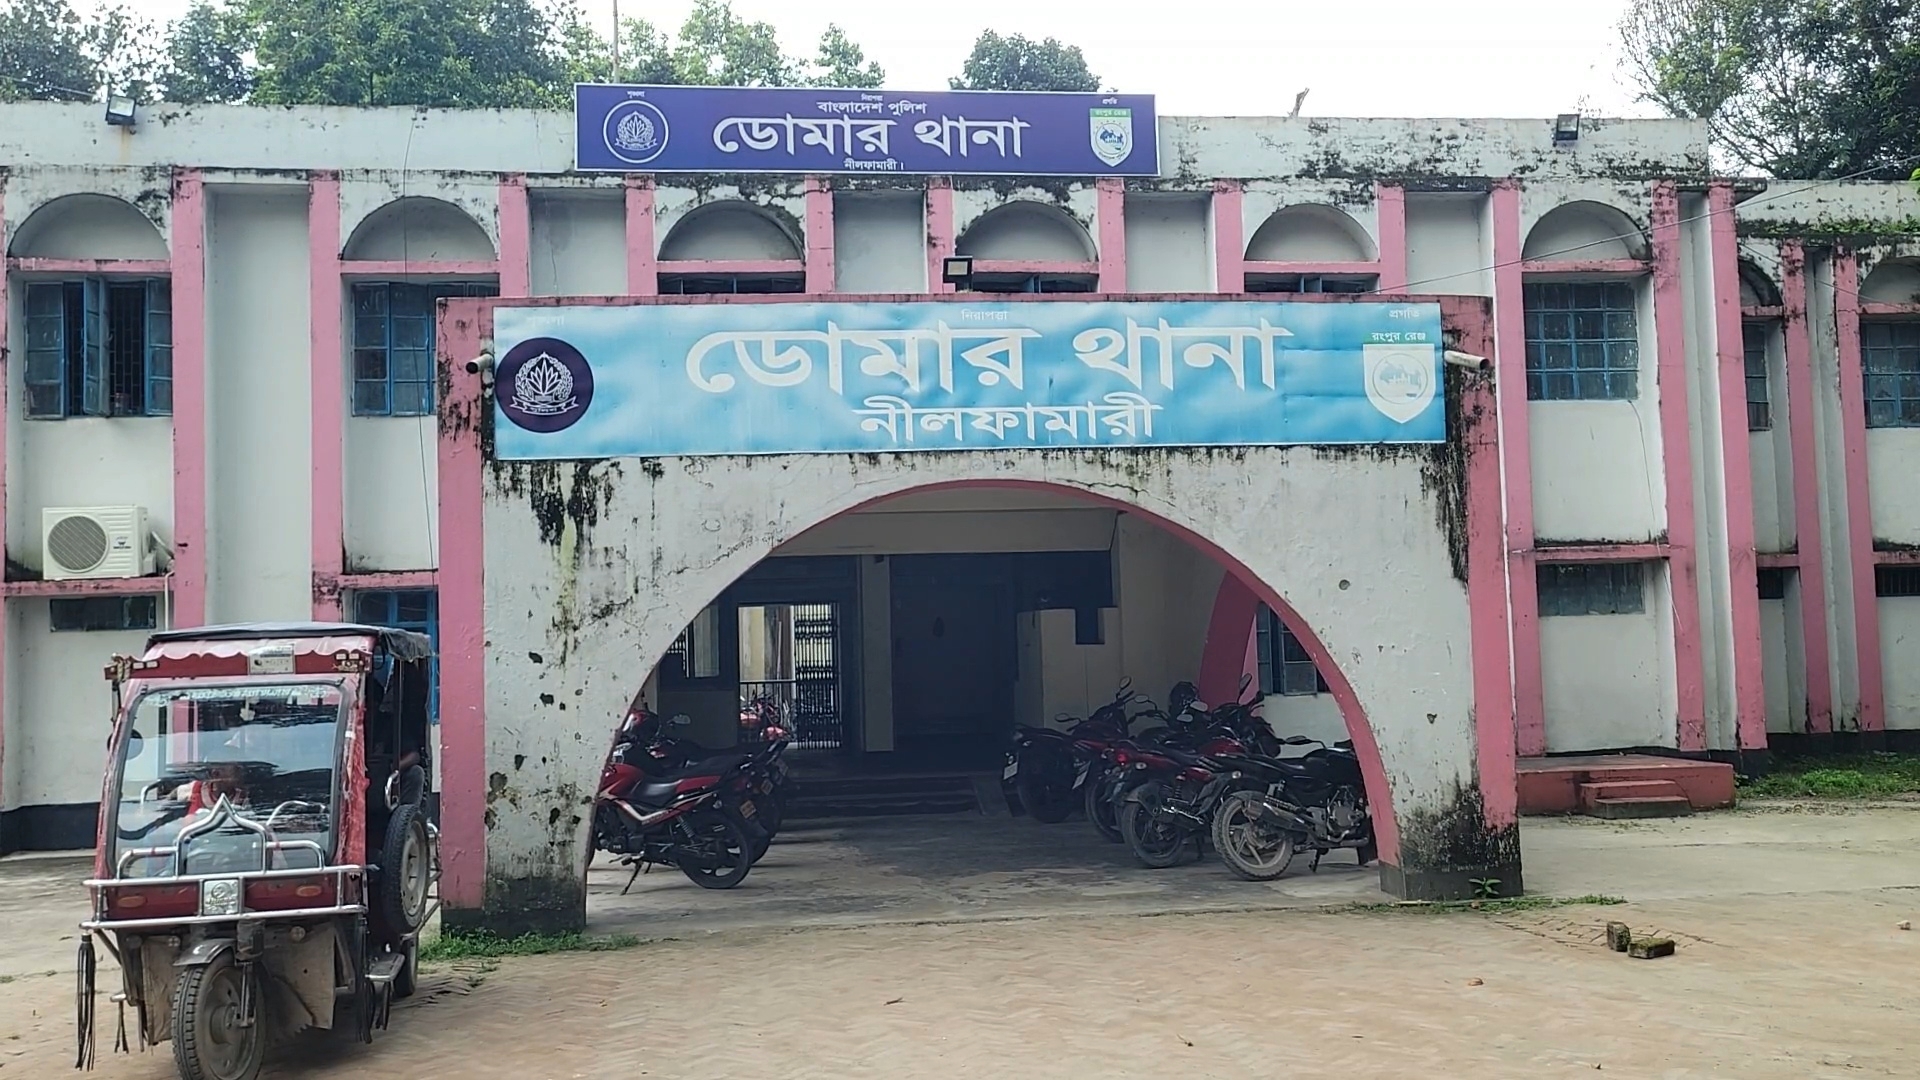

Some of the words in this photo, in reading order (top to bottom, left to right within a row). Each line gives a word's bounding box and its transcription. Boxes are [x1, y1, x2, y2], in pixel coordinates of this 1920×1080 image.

[816, 101, 884, 114] বাংলাদেশ
[888, 100, 927, 116] পুলিশ
[713, 113, 897, 156] ডোমার
[914, 115, 1031, 157] থানা
[843, 157, 898, 171] নীলফামারী
[1371, 331, 1401, 343] রংপুর
[686, 320, 1042, 395] ডোমার
[1072, 317, 1295, 391] থানা
[852, 393, 1163, 442] নীলফামারী
